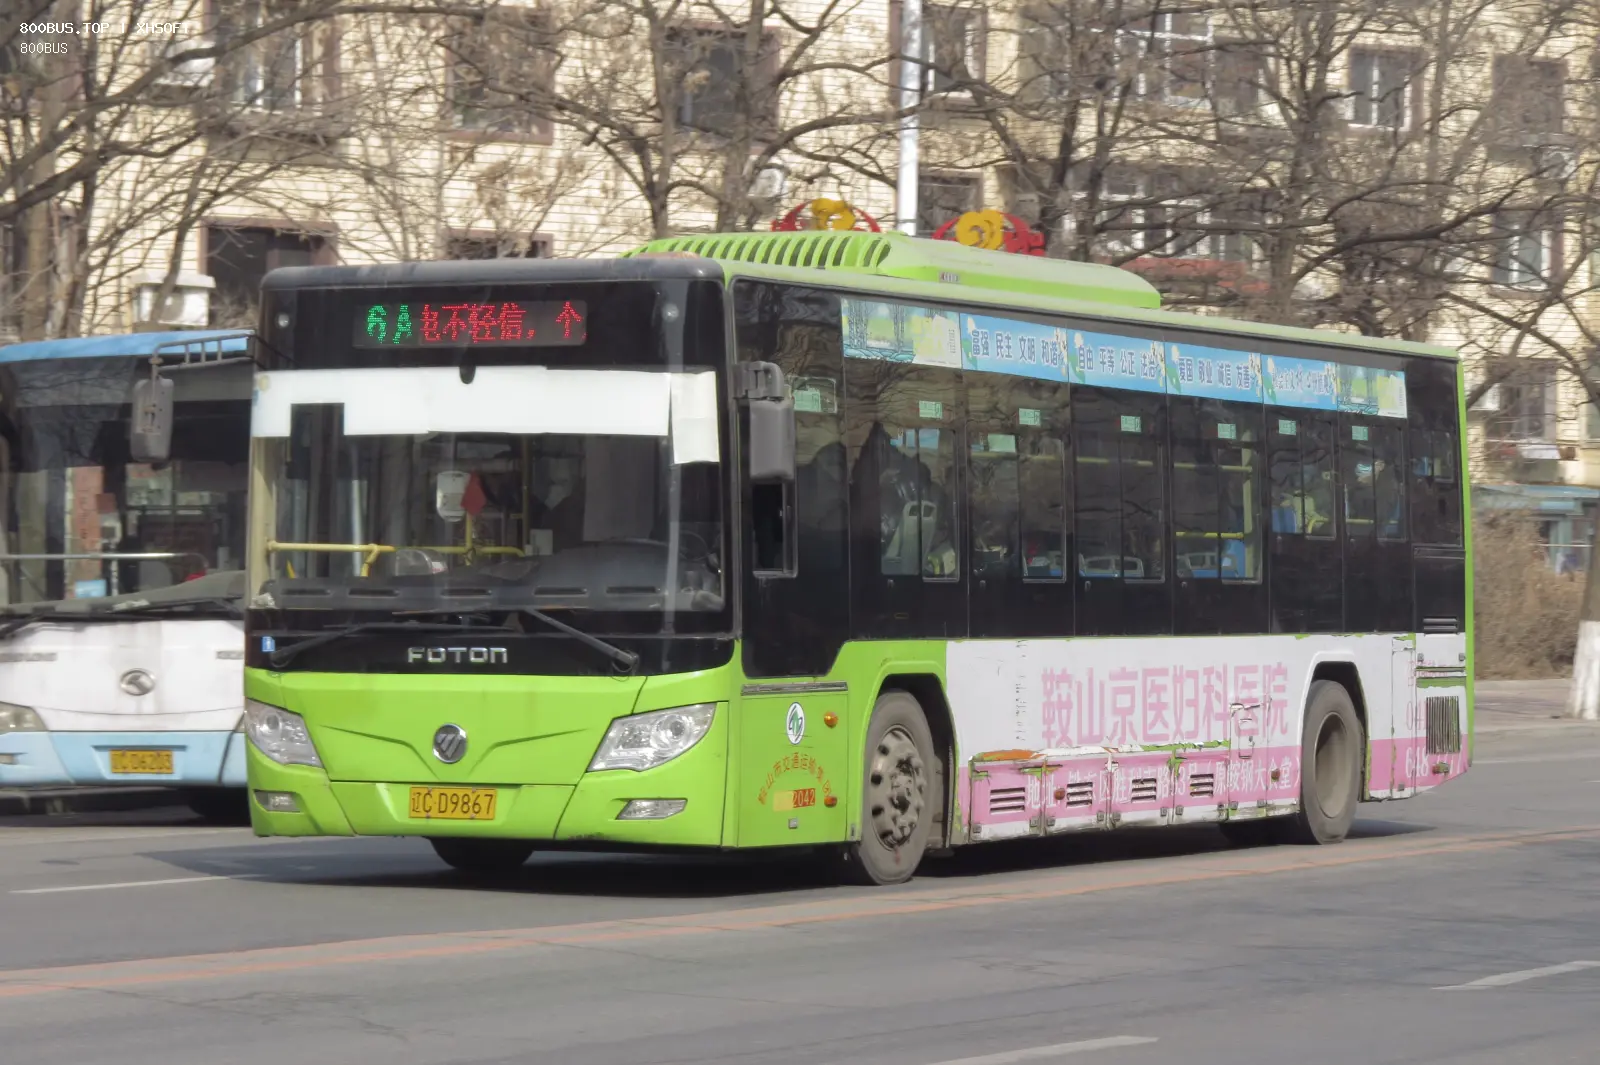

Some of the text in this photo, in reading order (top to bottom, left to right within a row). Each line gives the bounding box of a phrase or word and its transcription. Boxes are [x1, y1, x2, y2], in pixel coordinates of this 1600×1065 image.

[367, 304, 412, 344] 6A
[971, 330, 990, 357] 富强
[995, 332, 1013, 360] 民主
[1019, 335, 1036, 363] 文明
[1041, 339, 1059, 367] 和谐
[1078, 344, 1157, 378] 自由 平等 公正 法治
[1178, 357, 1251, 390] 爱国 敬业 诚信 友善
[407, 646, 508, 664] FOTON
[1041, 661, 1289, 749] 鞍山京医妇科医院
